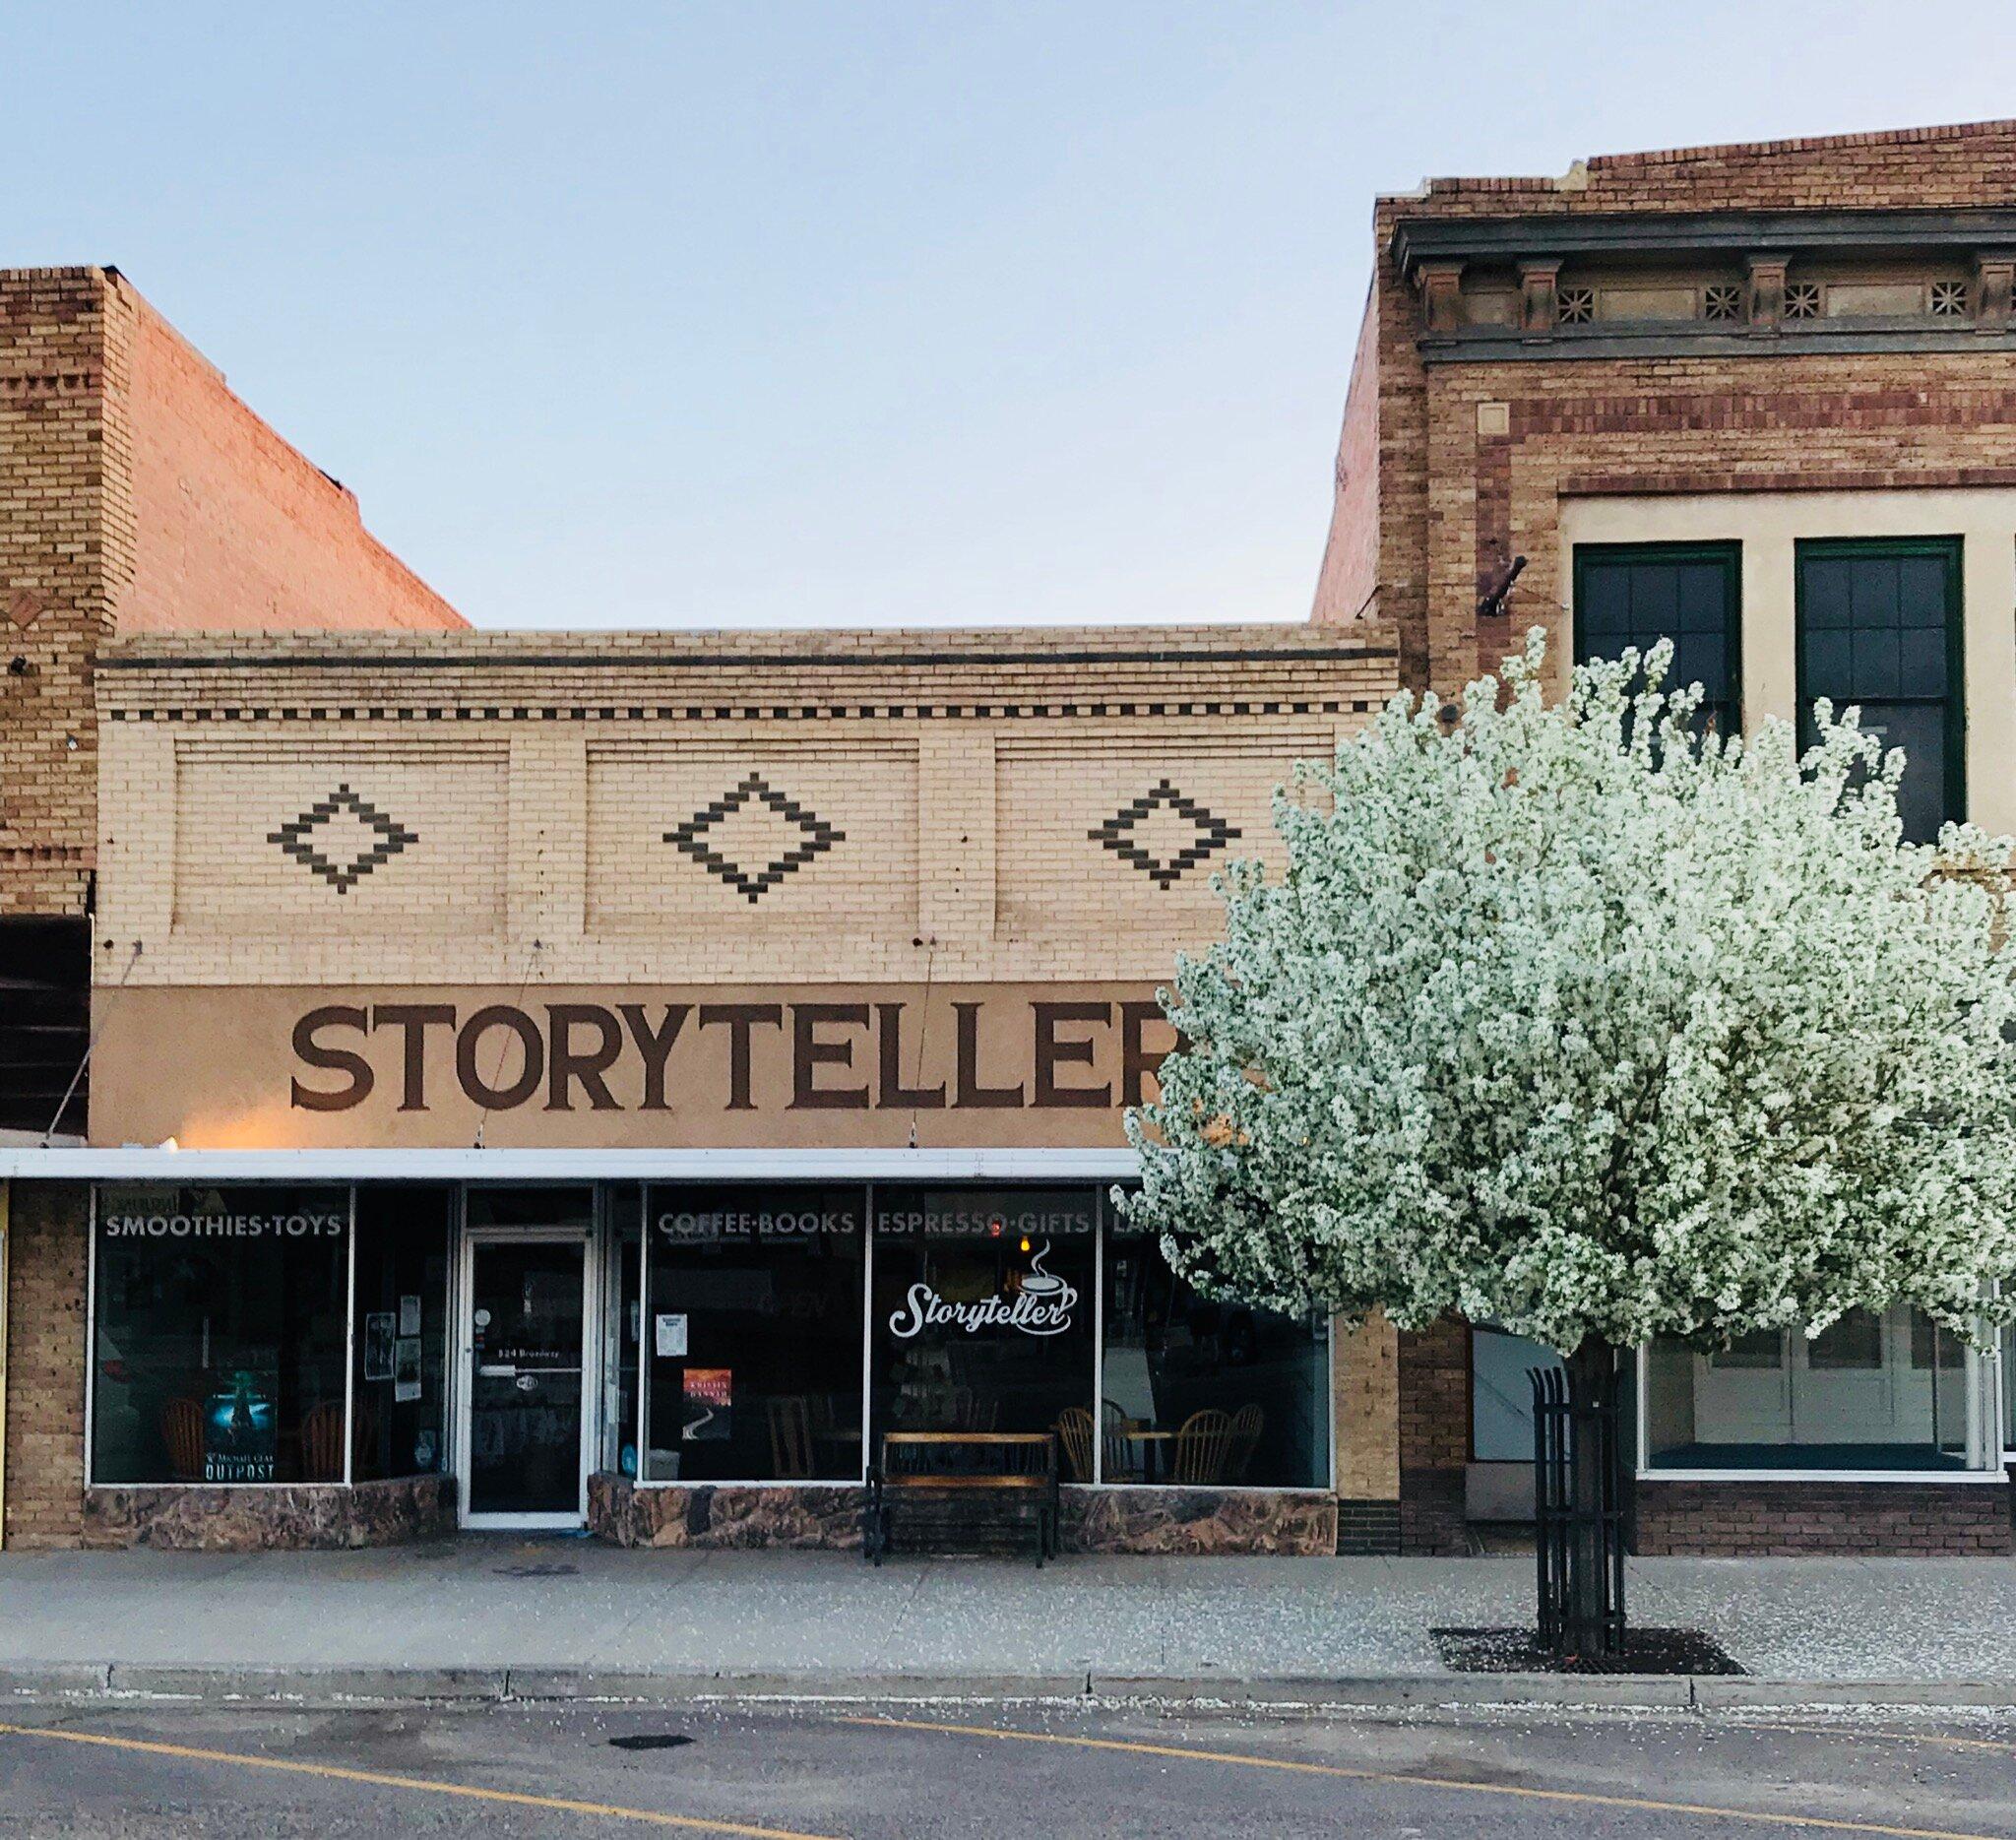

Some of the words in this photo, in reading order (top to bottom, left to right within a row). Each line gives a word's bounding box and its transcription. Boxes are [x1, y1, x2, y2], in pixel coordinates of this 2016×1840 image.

[290, 1001, 1195, 1112] STORYTELLER
[888, 1282, 1066, 1339] Storyteller
[206, 1464, 275, 1481] OUTPOST
